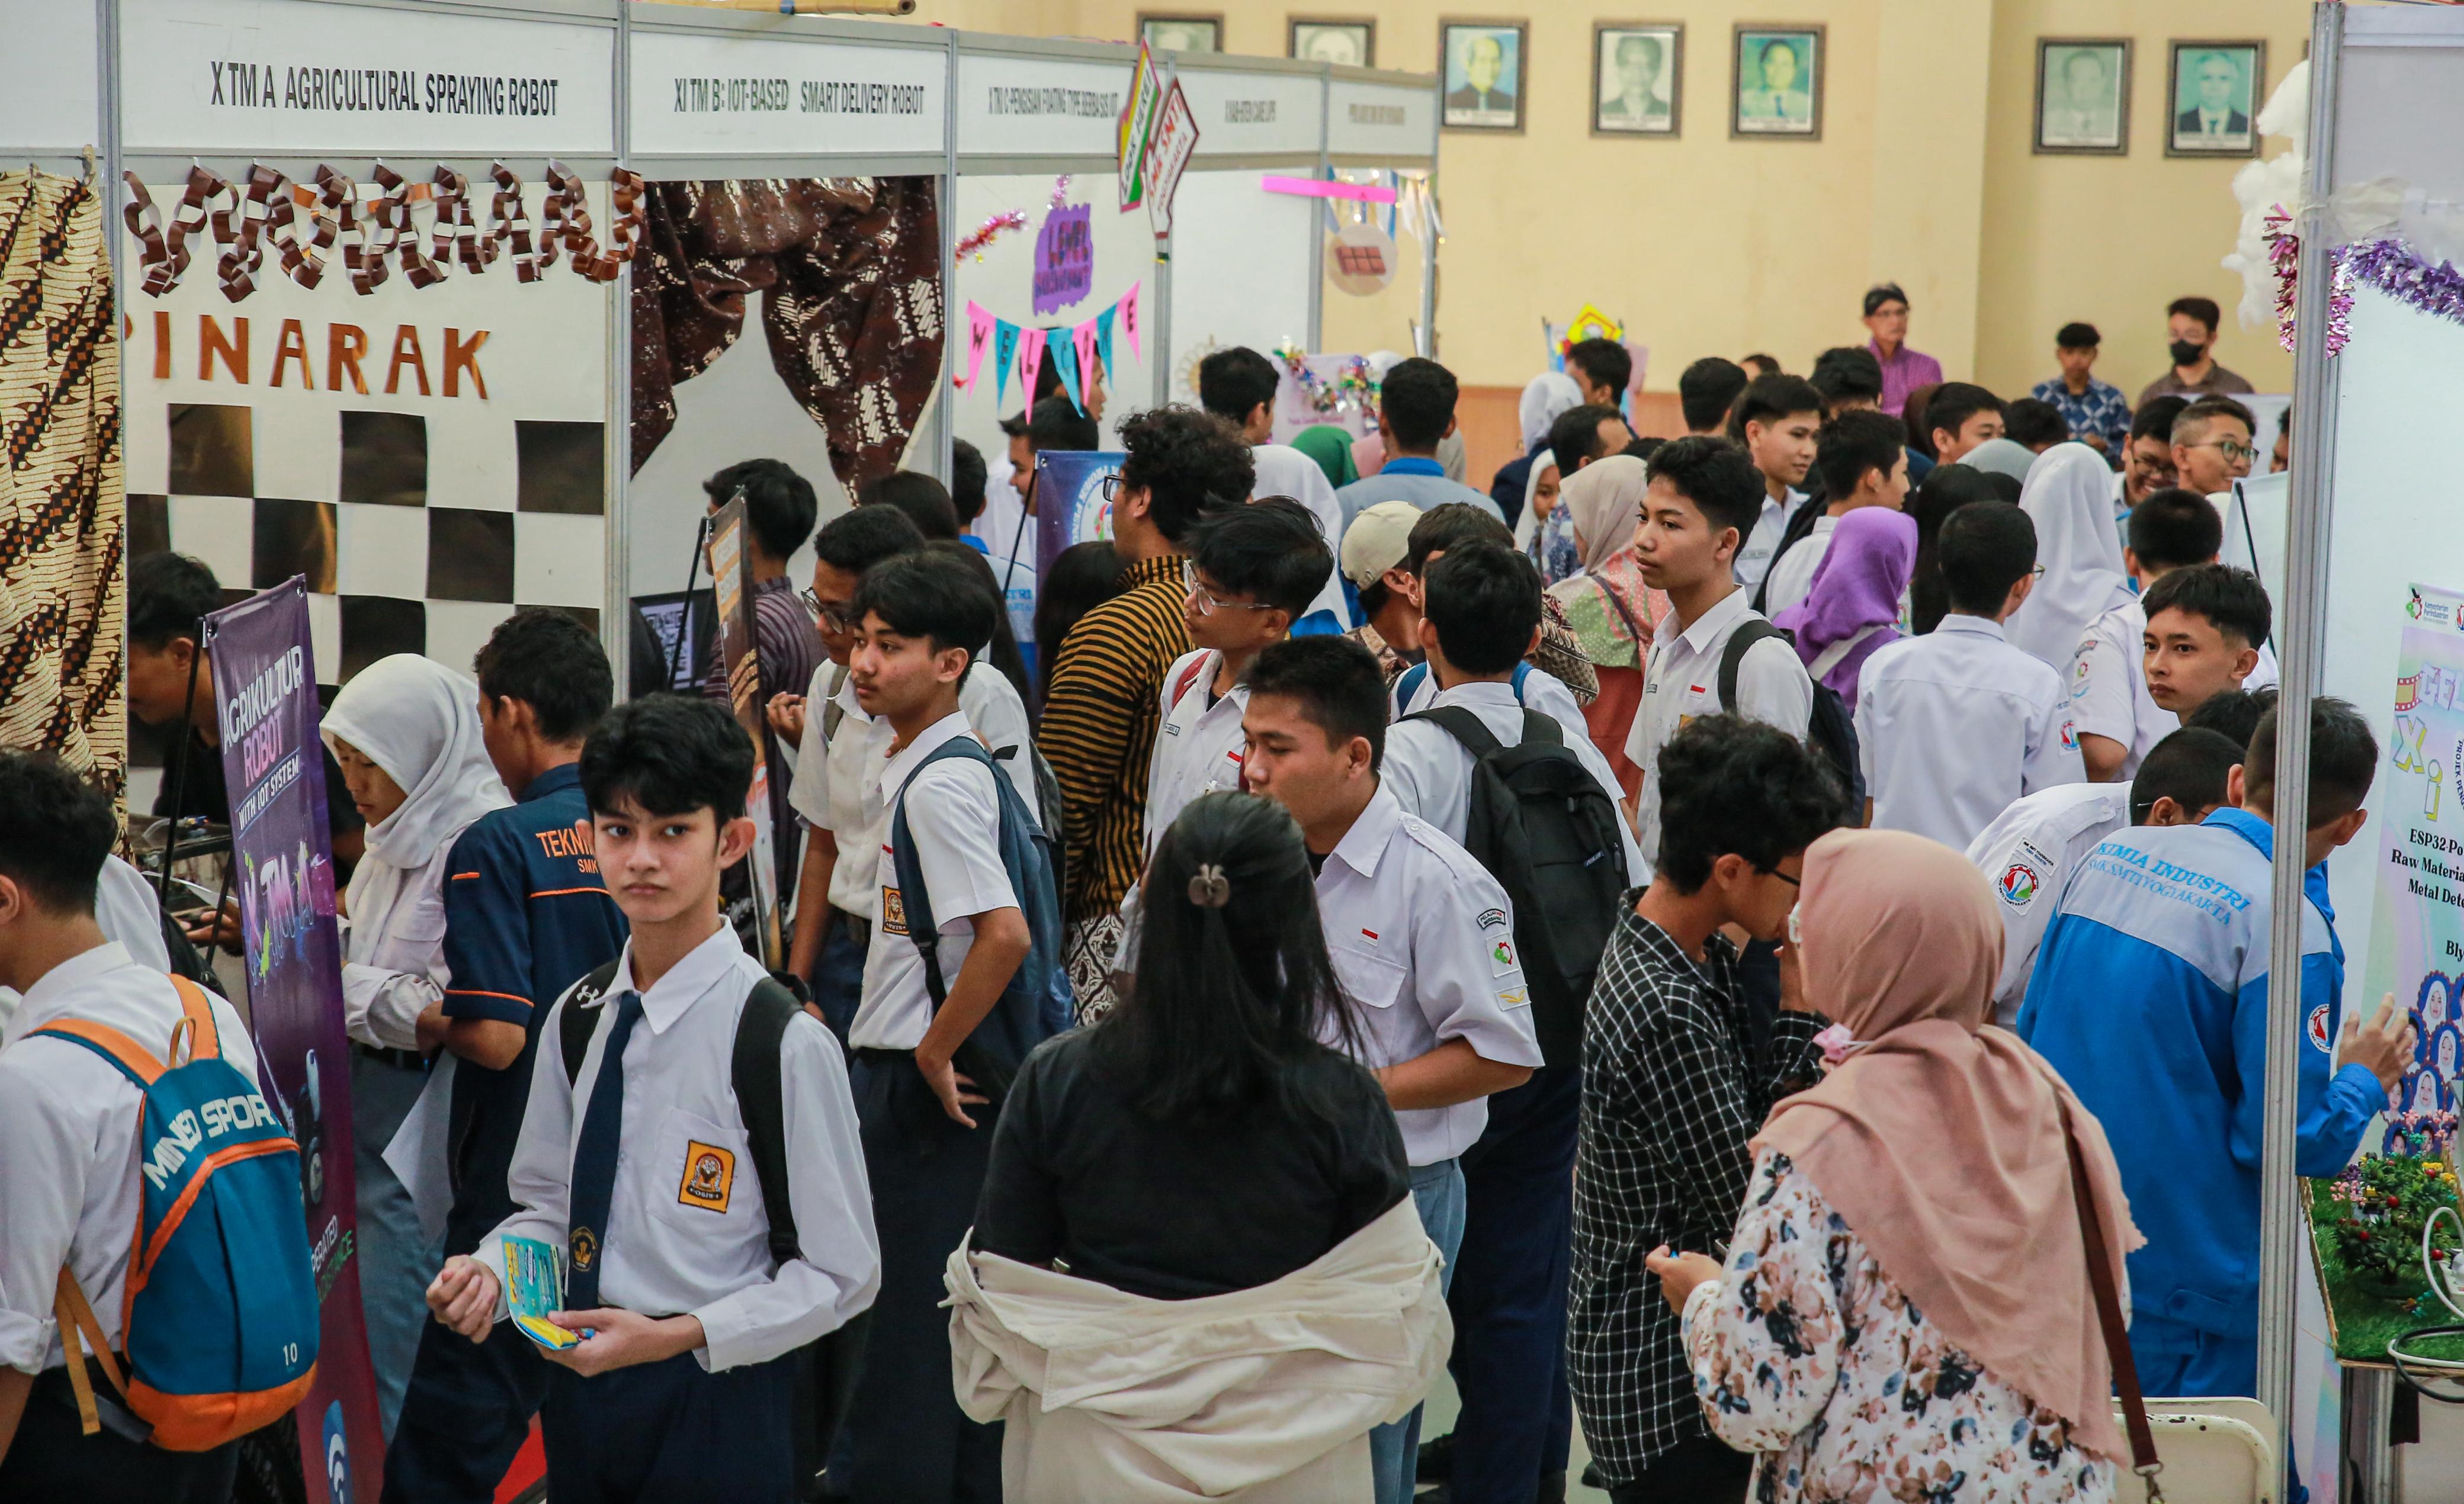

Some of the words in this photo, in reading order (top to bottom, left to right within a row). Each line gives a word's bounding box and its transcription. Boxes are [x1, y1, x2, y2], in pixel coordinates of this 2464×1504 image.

[210, 61, 224, 105] X
[227, 62, 256, 107] TM
[262, 65, 276, 108] A
[284, 66, 419, 111] AGRICULTURAL
[425, 73, 504, 115] SPRAYING
[508, 78, 559, 116] ROBOT
[674, 78, 686, 112] XI
[689, 78, 708, 112] TM
[712, 79, 724, 111] B:
[728, 78, 789, 111] IOT-BASED
[800, 81, 839, 113] SMART
[841, 82, 890, 114] DELIVERY
[892, 85, 924, 114] ROBOT
[123, 310, 491, 400] INARAK
[2424, 609, 2449, 620] Perindustrian
[222, 645, 304, 755] AGRIKULTUR
[243, 707, 284, 788] ROBOT
[239, 796, 256, 830] WITH
[258, 783, 270, 813] IOT
[270, 754, 300, 798] SYSTEM
[535, 828, 592, 859] TEKN
[2391, 849, 2420, 869] Raw
[2410, 828, 2464, 856] ESP32-Po
[578, 859, 599, 874] SMK
[2096, 843, 2150, 869] KIMIA
[2150, 860, 2251, 912] INDUSTRI
[2408, 878, 2439, 901] Metal
[201, 1094, 283, 1138] SPOR
[283, 1342, 298, 1365] 10
